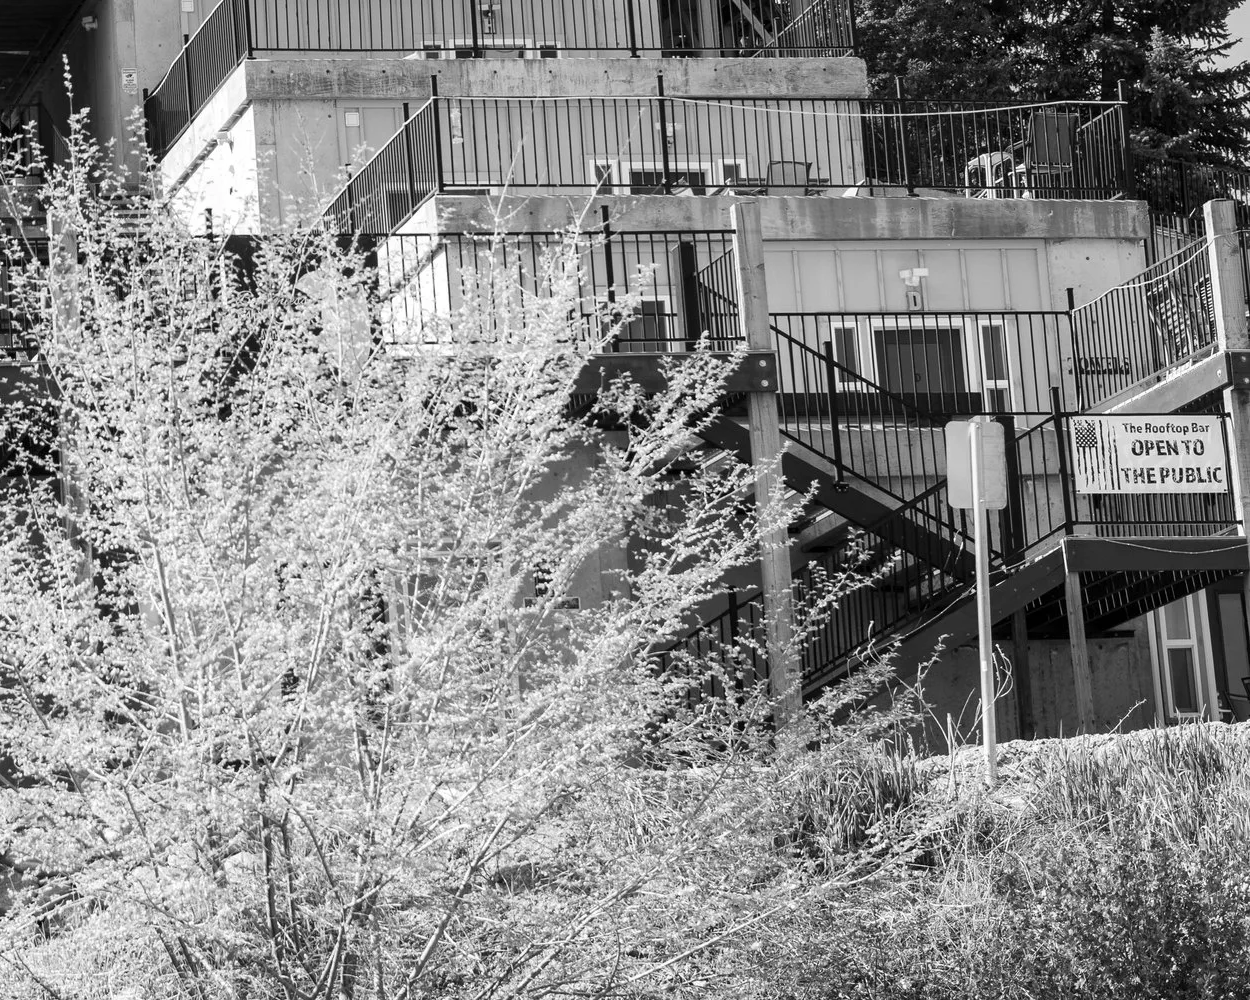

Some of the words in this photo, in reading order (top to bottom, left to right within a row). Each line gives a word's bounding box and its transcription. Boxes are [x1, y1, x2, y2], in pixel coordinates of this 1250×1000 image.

[906, 291, 922, 311] D
[1122, 422, 1143, 434] The
[1145, 422, 1189, 435] Rooftop
[1191, 422, 1210, 433] Bar
[1131, 439, 1180, 456] OPEN
[1181, 439, 1205, 456] TO
[1121, 467, 1157, 484] THE
[1159, 466, 1223, 484] PUBLIC
